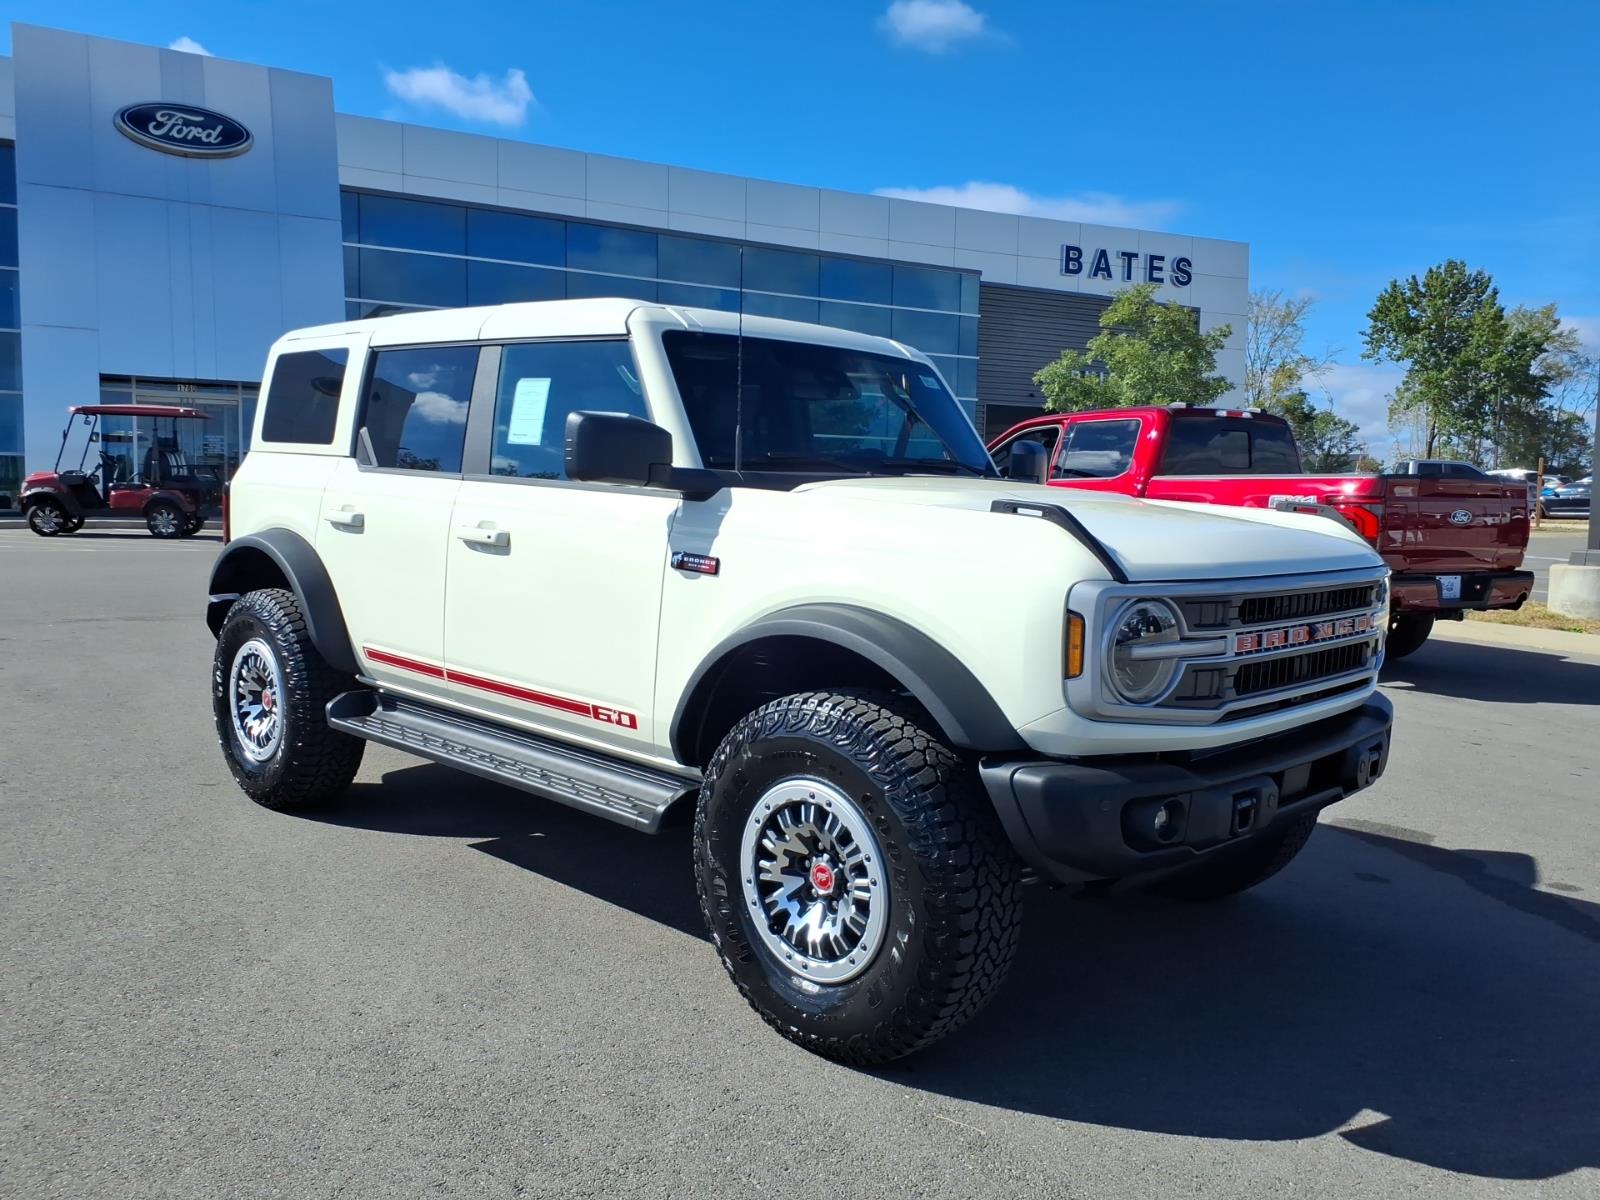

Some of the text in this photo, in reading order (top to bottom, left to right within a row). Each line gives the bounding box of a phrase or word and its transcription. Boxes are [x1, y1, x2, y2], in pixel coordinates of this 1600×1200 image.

[148, 110, 223, 143] Ford
[1062, 244, 1192, 286] BATES
[684, 556, 715, 565] BRONCO
[1236, 616, 1375, 652] BRONCO
